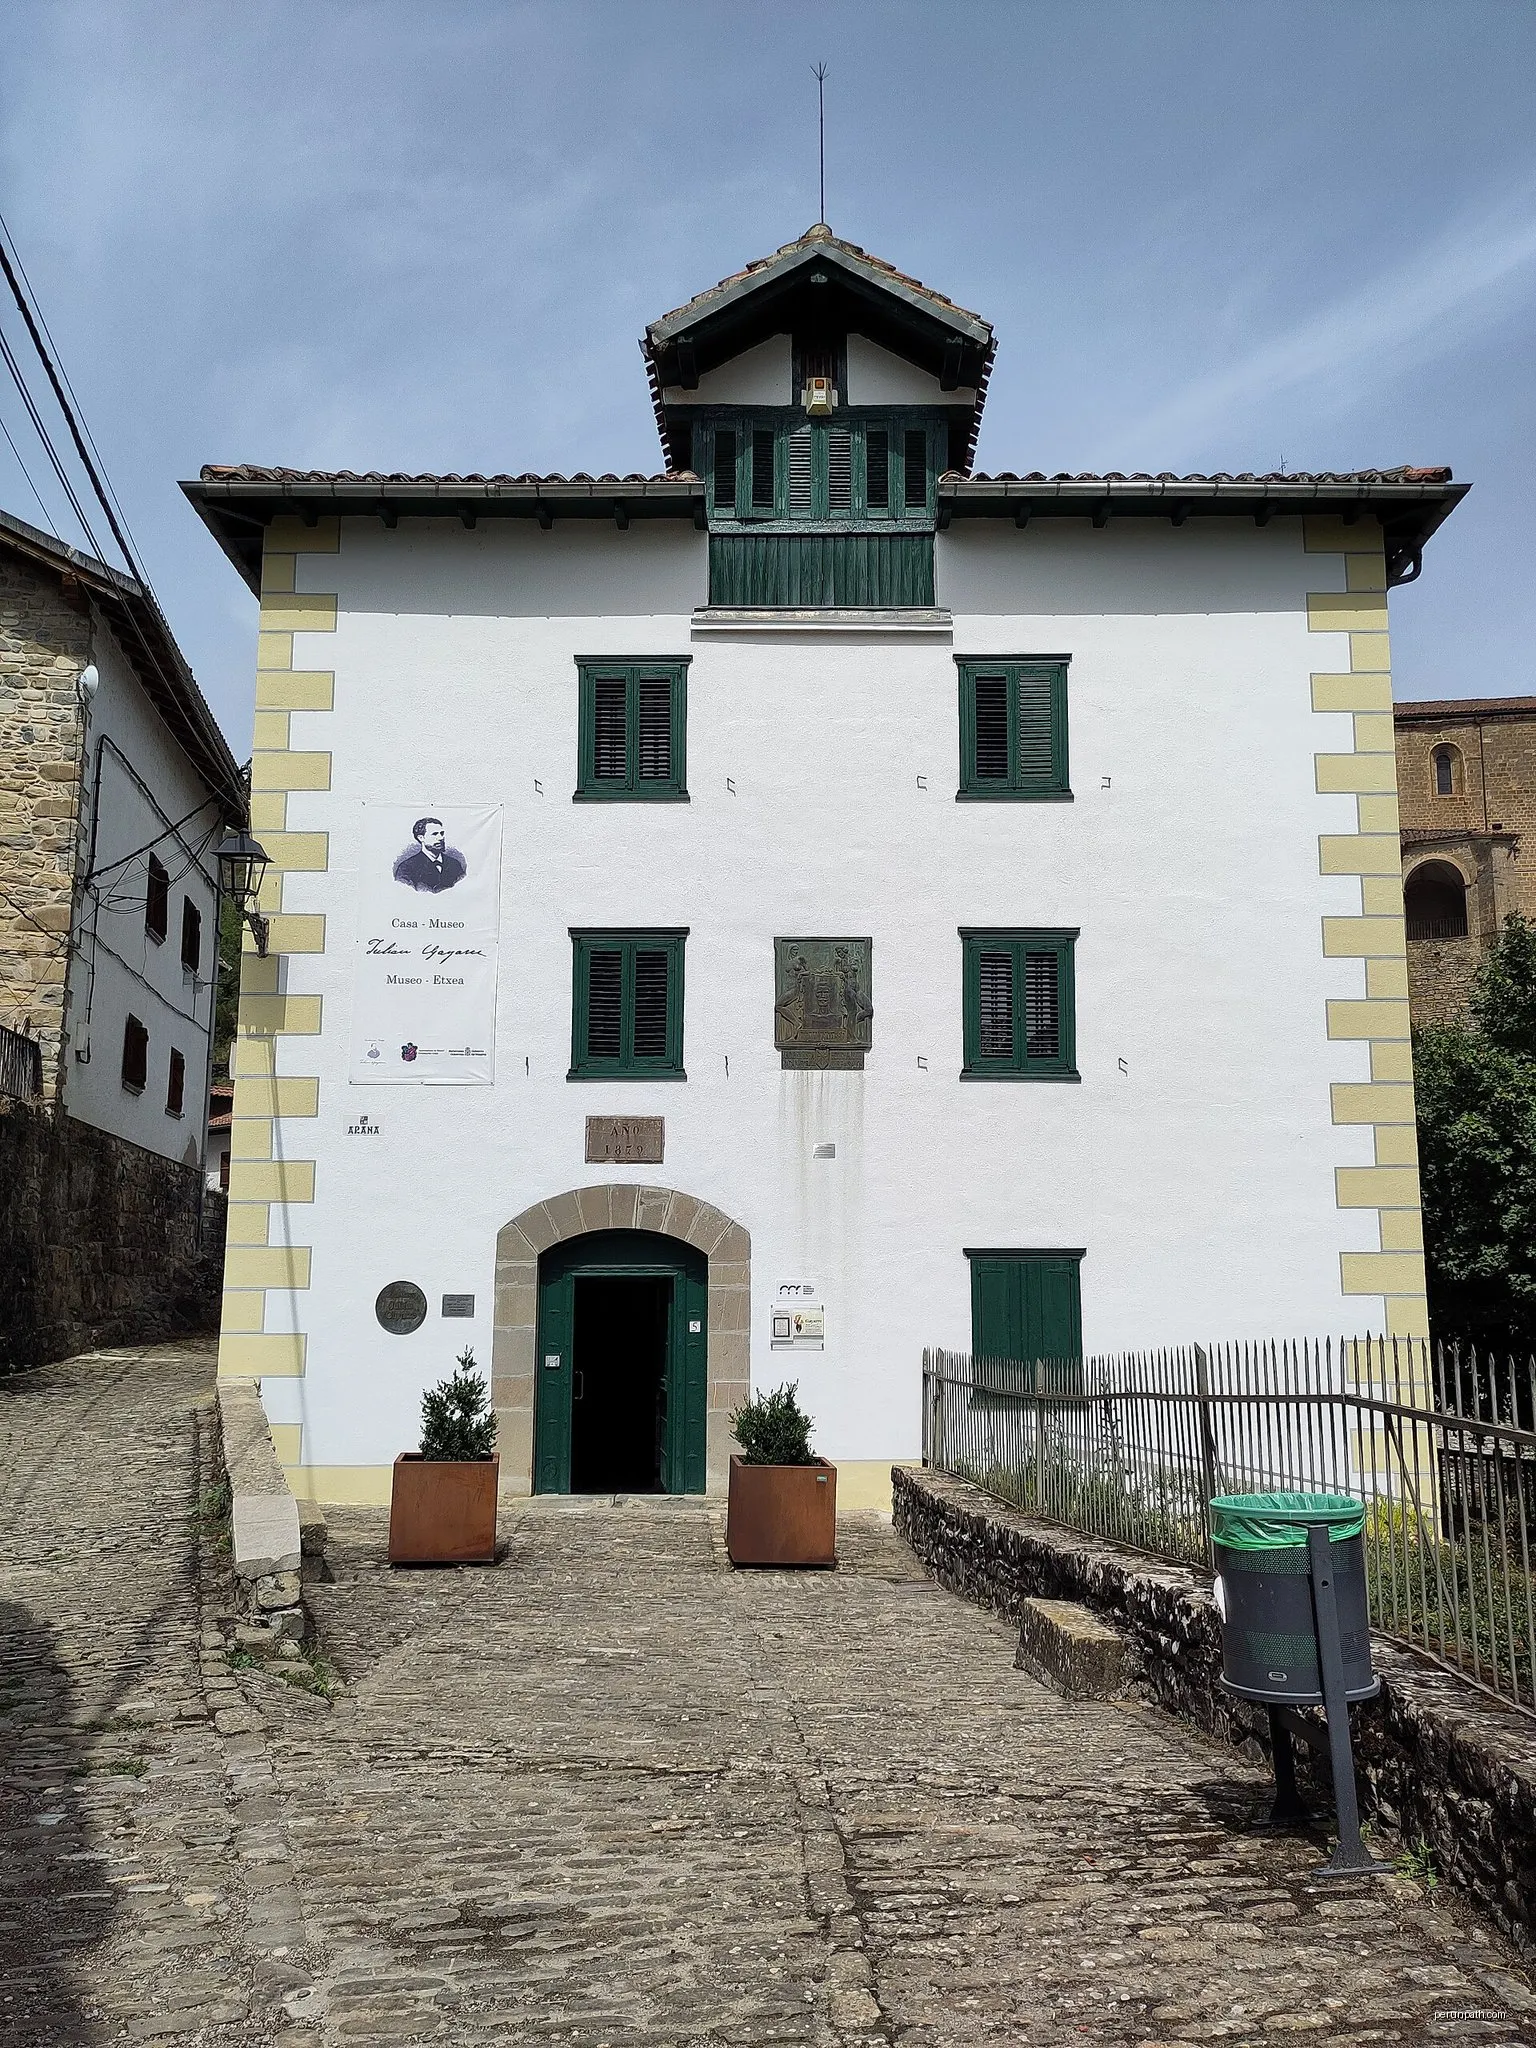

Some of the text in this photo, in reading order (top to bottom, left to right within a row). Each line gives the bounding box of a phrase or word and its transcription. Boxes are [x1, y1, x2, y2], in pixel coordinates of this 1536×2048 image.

[391, 917, 418, 928] Casa
[428, 918, 465, 929] Museo
[386, 974, 422, 985] Museo
[433, 974, 465, 985] Etxea
[691, 1321, 698, 1332] 5
